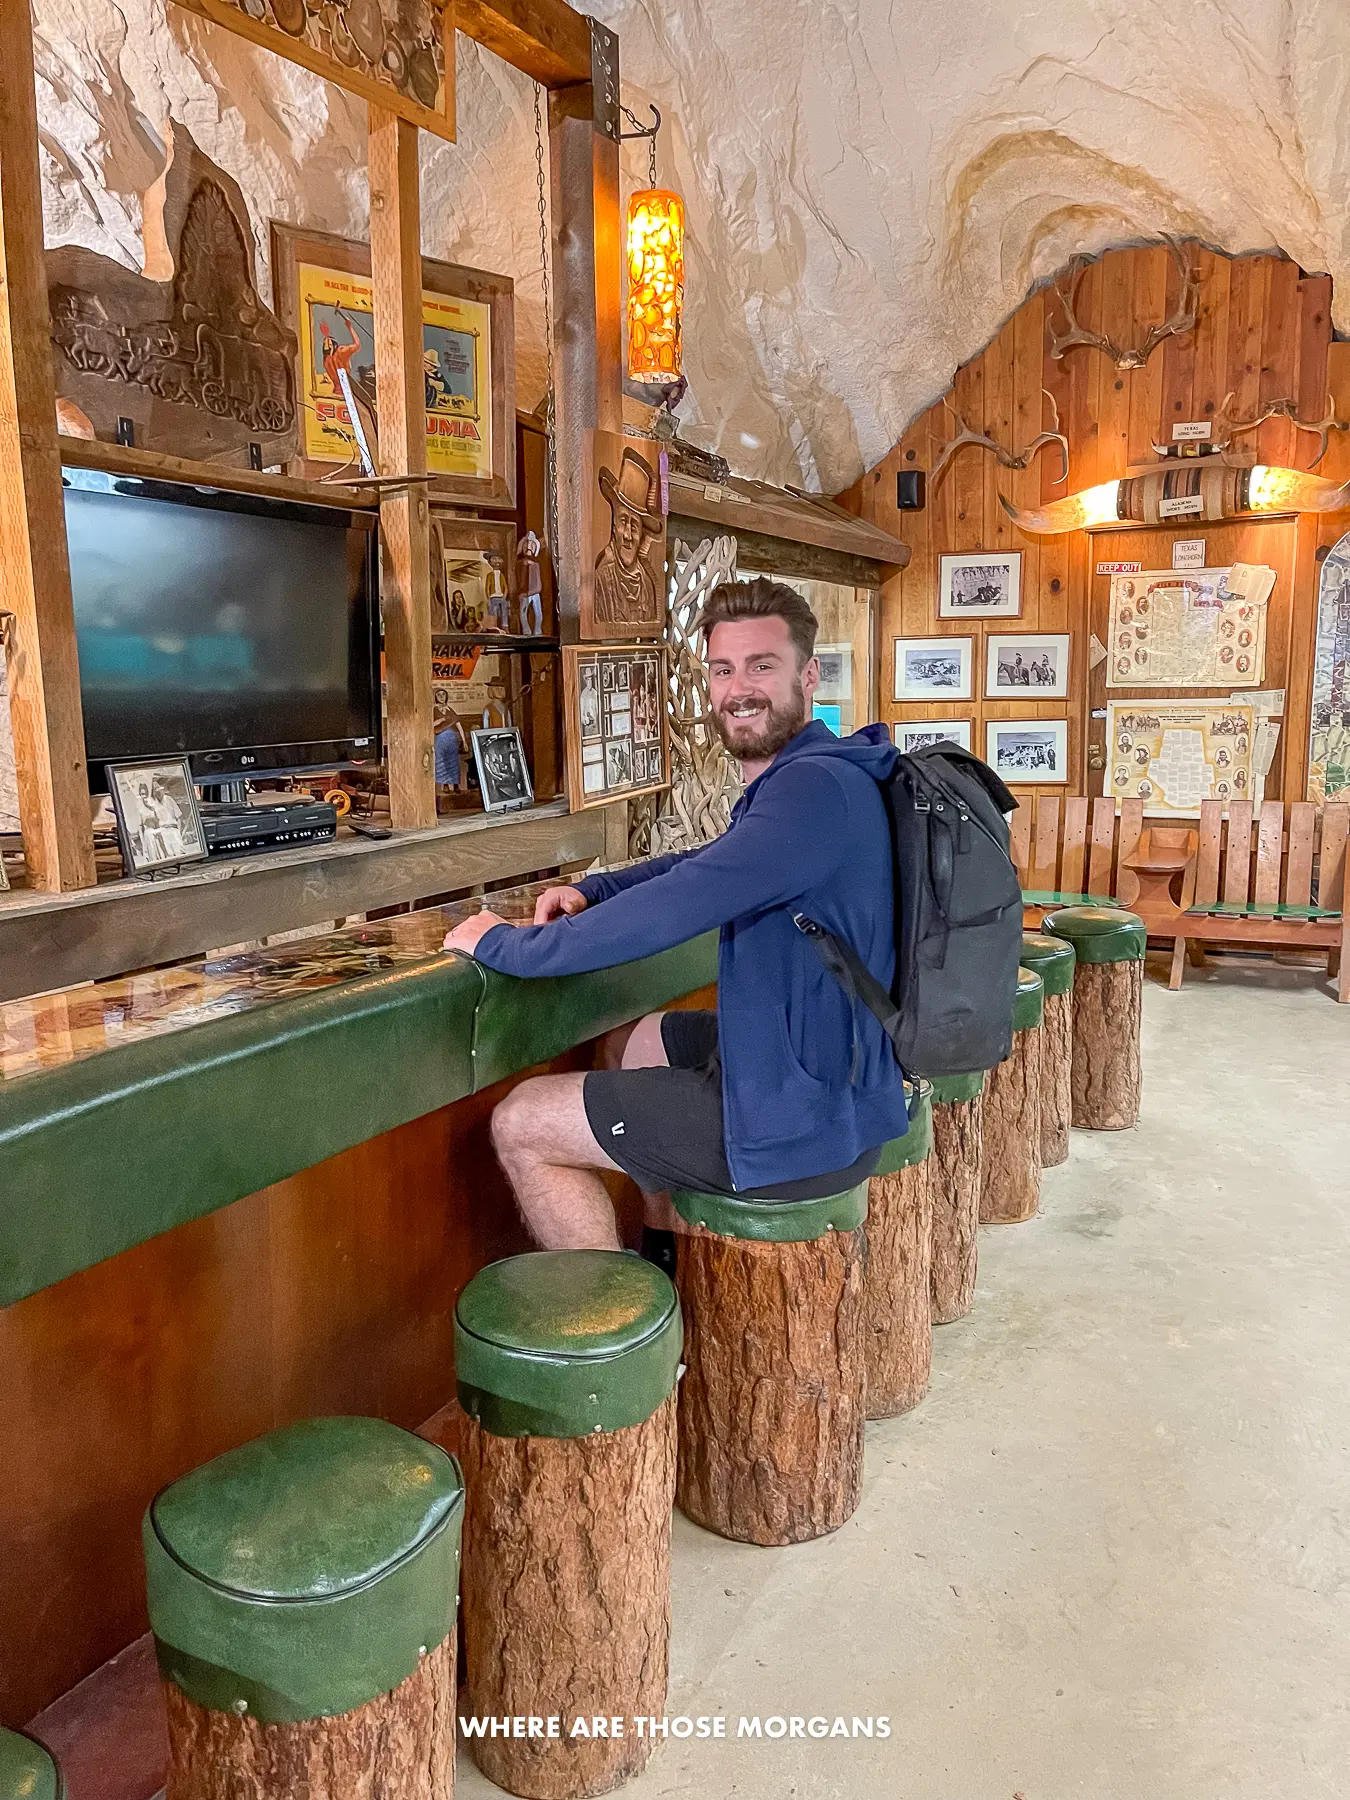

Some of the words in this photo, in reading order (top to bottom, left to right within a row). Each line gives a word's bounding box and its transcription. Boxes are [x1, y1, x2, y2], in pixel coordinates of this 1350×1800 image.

[425, 416, 482, 441] UMA
[1175, 554, 1203, 562] LONGHORN
[1099, 563, 1120, 572] KEEP
[1121, 563, 1139, 572] OUT
[432, 643, 474, 659] HAWK
[432, 662, 464, 677] RAIL
